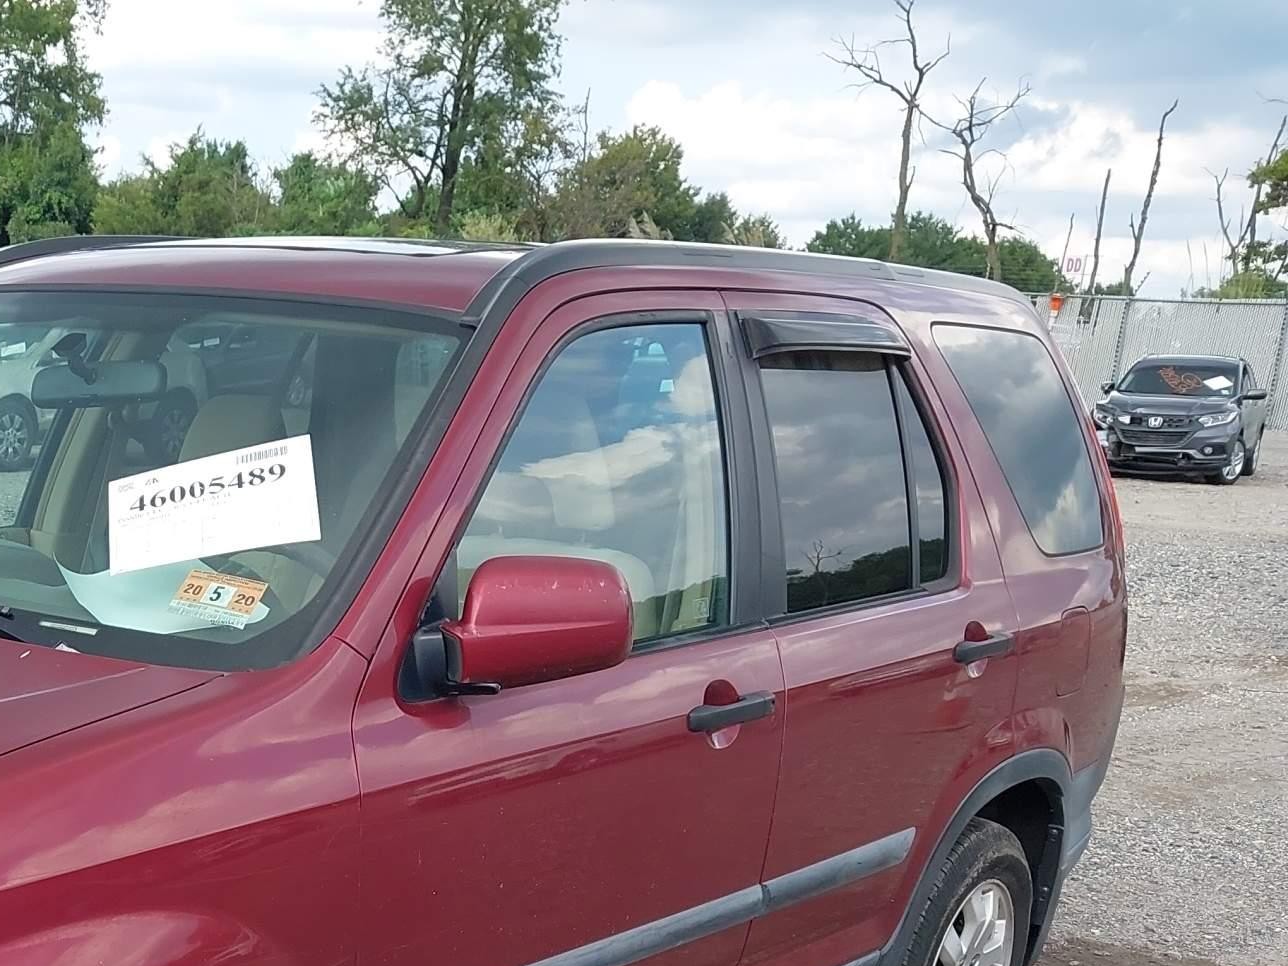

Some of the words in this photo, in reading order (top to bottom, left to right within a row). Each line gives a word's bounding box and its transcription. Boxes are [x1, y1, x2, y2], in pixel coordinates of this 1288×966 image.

[129, 463, 286, 511] 46005489
[183, 583, 203, 596] 20
[209, 586, 225, 602] 5
[234, 593, 256, 607] 20
